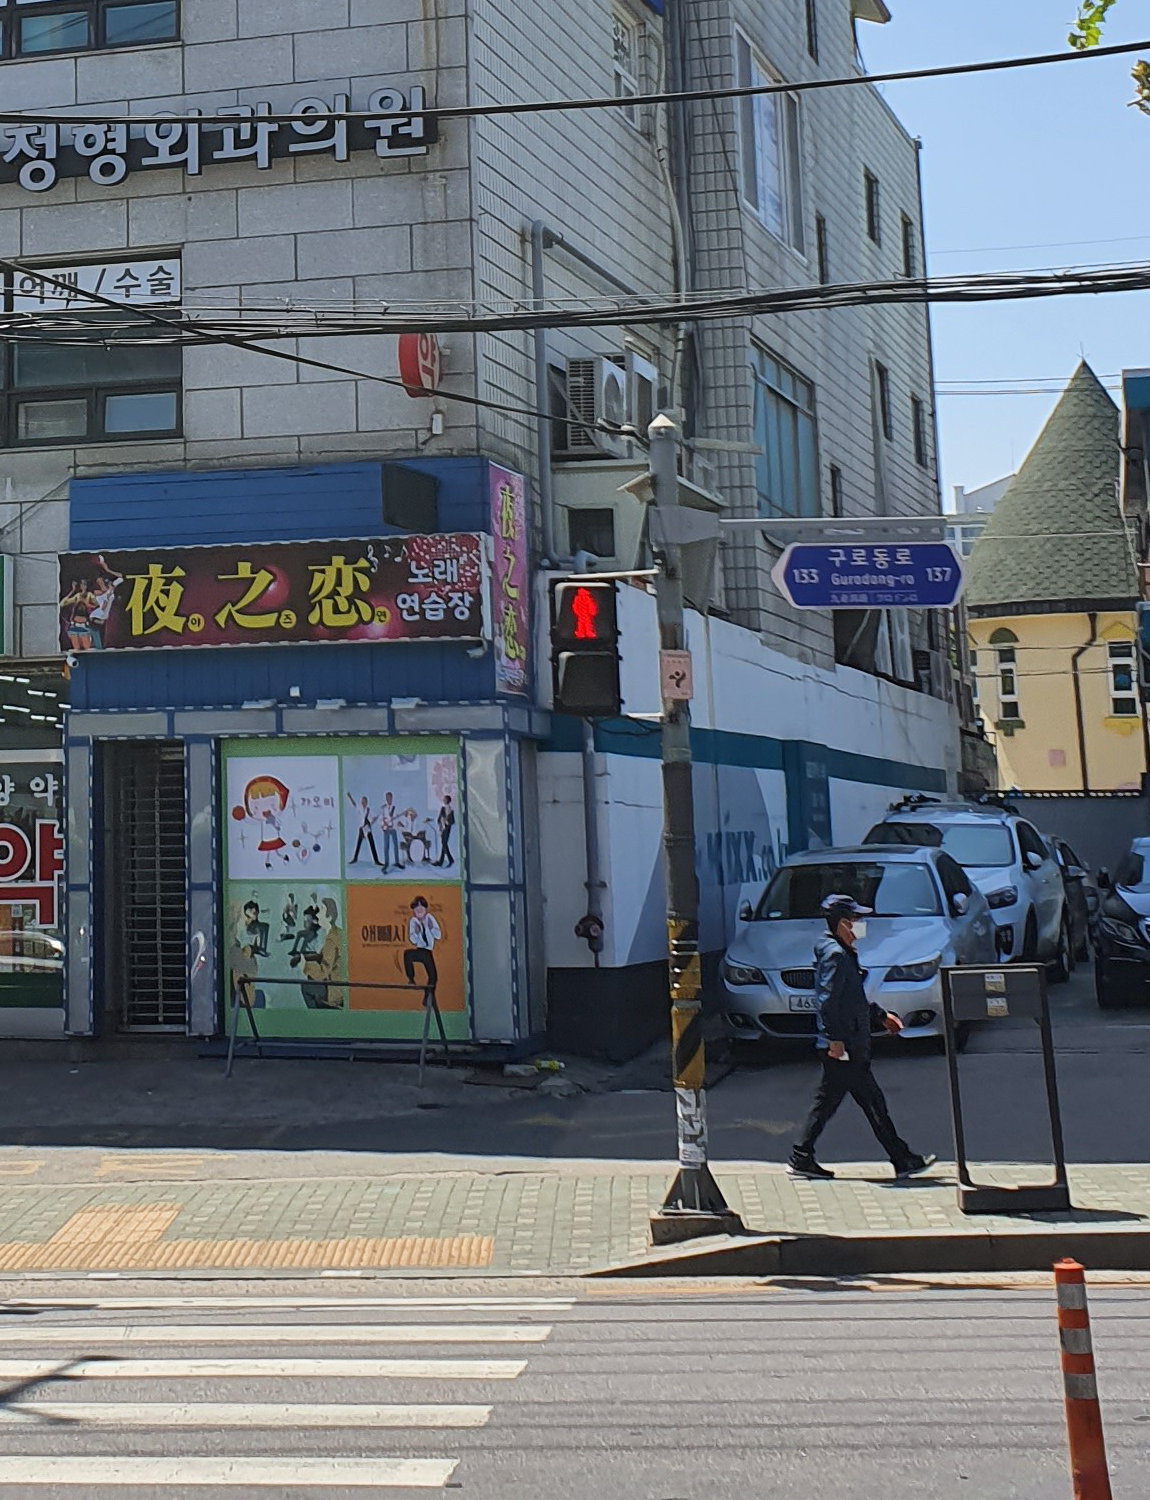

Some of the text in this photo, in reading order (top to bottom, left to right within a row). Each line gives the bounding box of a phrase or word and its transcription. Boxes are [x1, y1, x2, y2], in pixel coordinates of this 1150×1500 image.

[827, 548, 914, 569] 구로동로
[407, 558, 459, 584] 노래
[830, 573, 915, 587] Gurodong-ro
[925, 567, 952, 582] 137
[395, 590, 473, 621] 연습장
